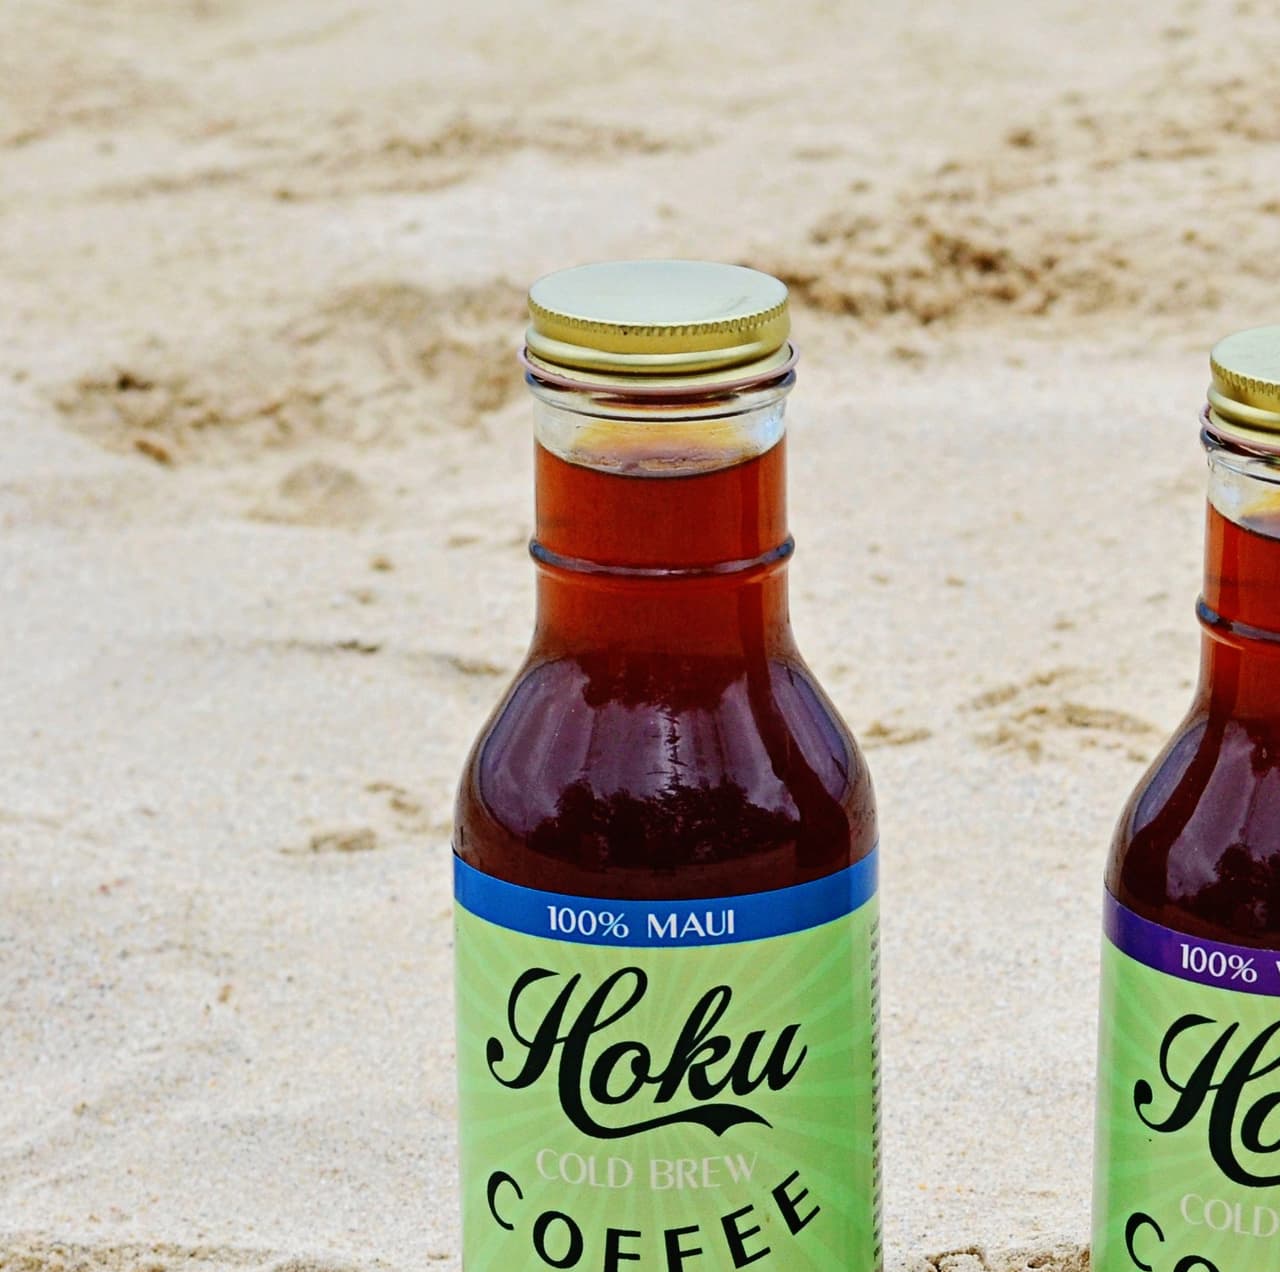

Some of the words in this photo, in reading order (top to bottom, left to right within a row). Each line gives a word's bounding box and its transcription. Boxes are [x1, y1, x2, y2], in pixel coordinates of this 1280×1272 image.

[547, 906, 629, 938] 100%
[647, 910, 734, 938] MAUI
[1180, 943, 1258, 984] 100%
[487, 966, 807, 1139] Hoku
[536, 1148, 633, 1188] COLD
[650, 1152, 758, 1190] BREW
[1180, 1193, 1280, 1238] COLD
